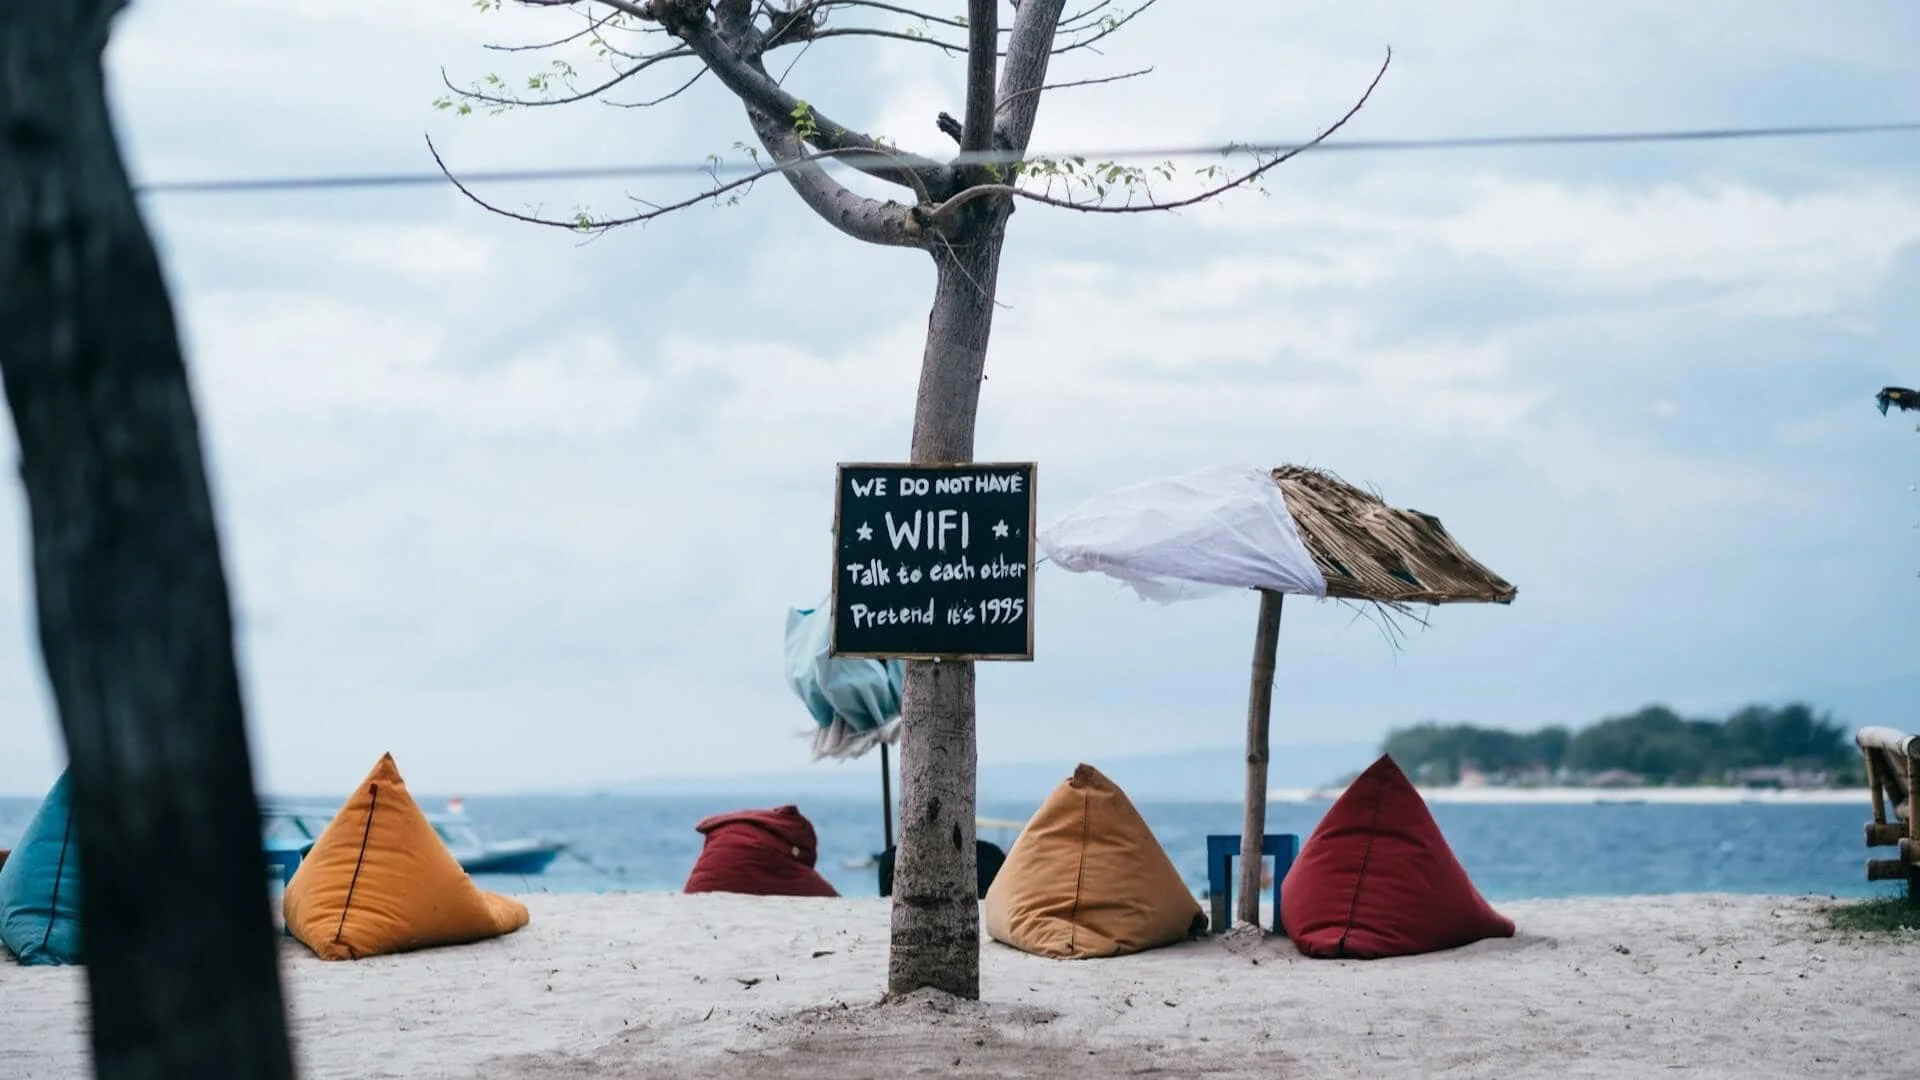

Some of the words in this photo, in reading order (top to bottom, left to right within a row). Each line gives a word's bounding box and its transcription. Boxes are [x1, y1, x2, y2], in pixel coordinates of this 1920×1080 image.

[851, 477, 888, 497] WE
[900, 477, 929, 496] DO
[935, 476, 973, 494] NOT
[975, 473, 1023, 493] HAVE
[885, 509, 969, 551] WIFI
[847, 558, 890, 586] Talk
[897, 562, 922, 584] to
[930, 555, 975, 582] each
[980, 552, 1026, 580] other
[851, 597, 934, 628] Pretend
[980, 597, 1024, 624] 1995
